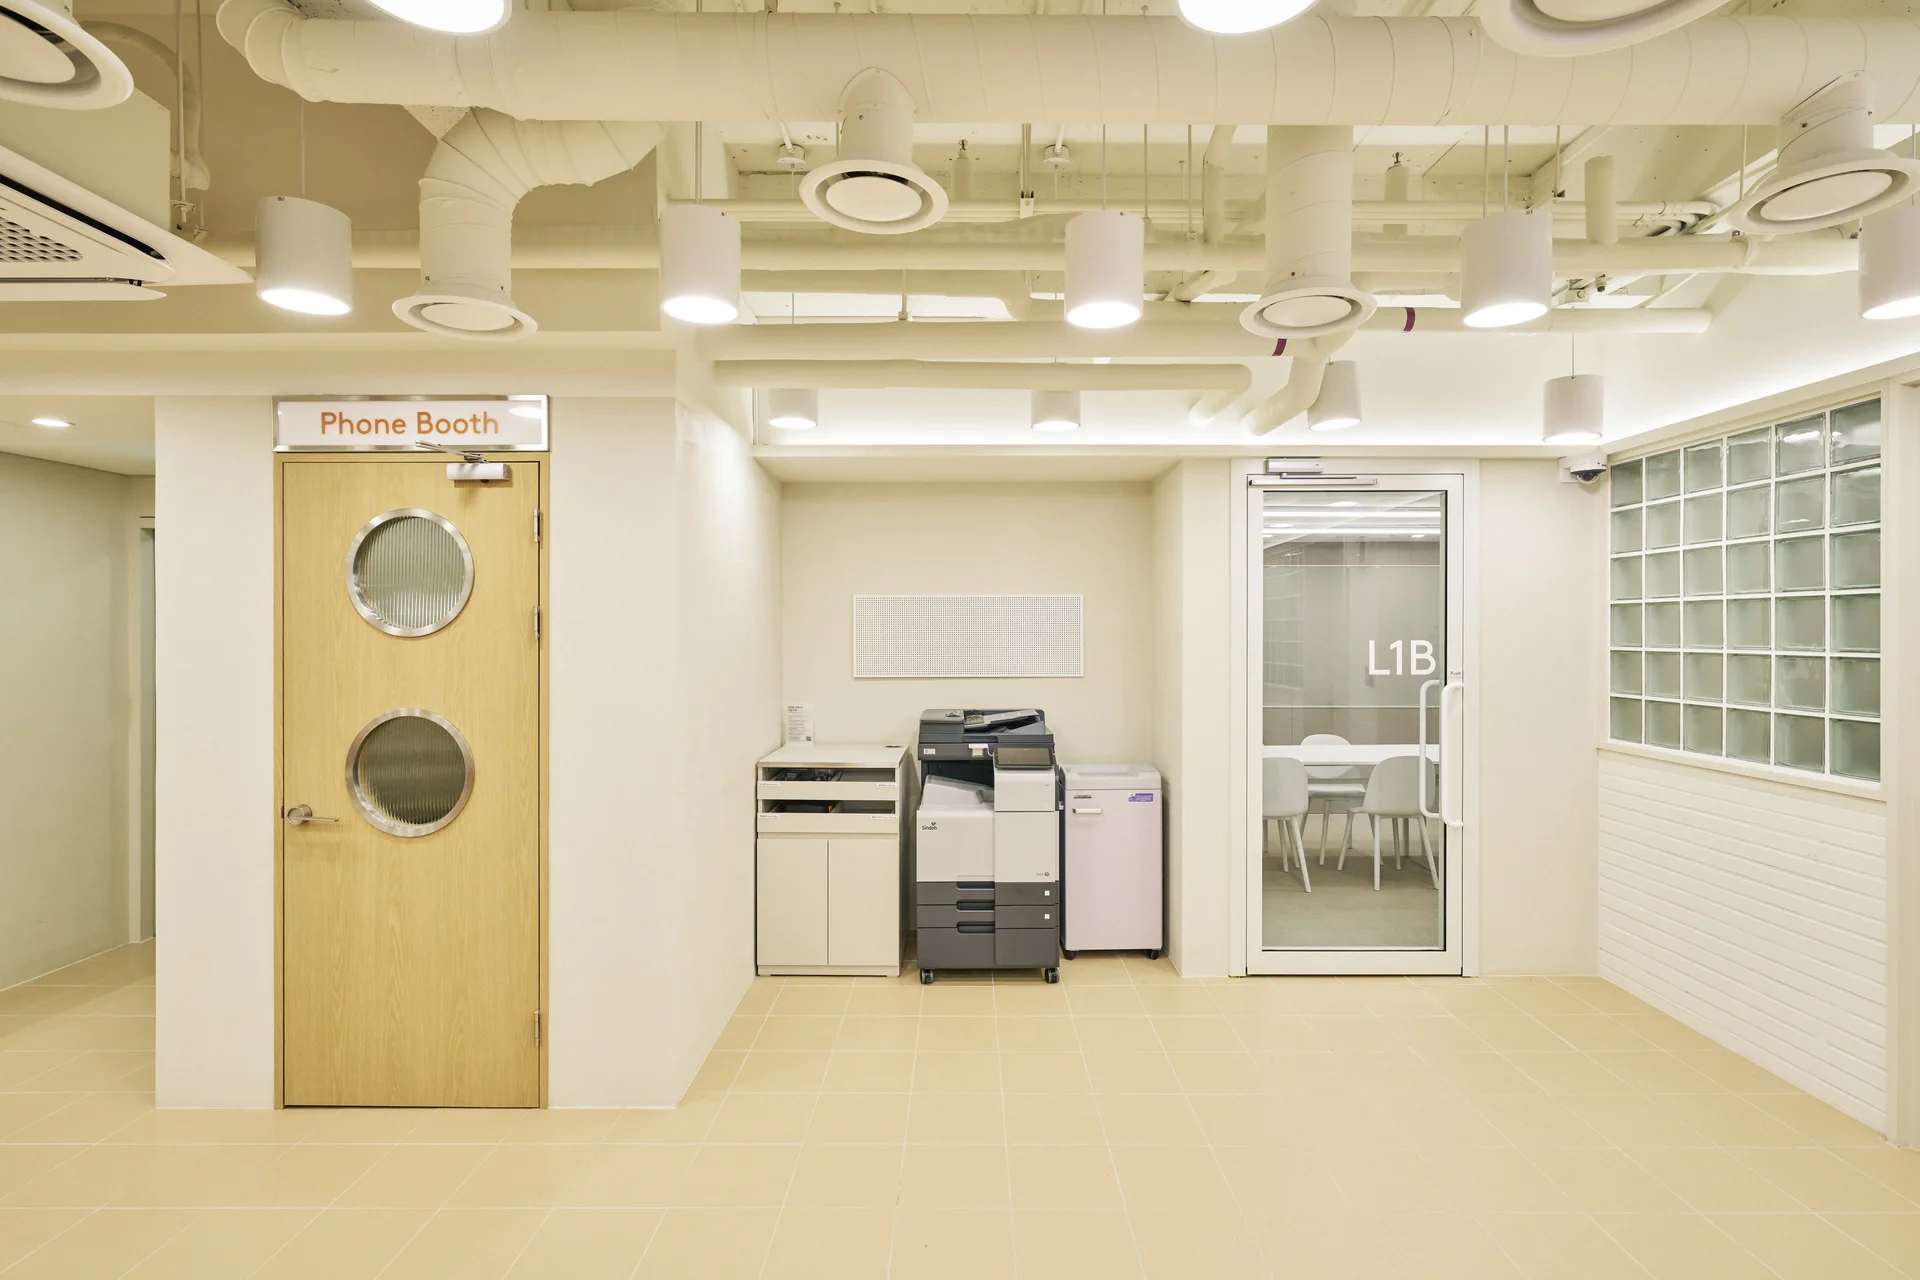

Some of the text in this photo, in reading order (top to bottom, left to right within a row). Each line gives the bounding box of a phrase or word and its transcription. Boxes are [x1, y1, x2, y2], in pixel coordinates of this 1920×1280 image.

[321, 411, 499, 435] Phone Booth
[1368, 640, 1436, 675] L1B
